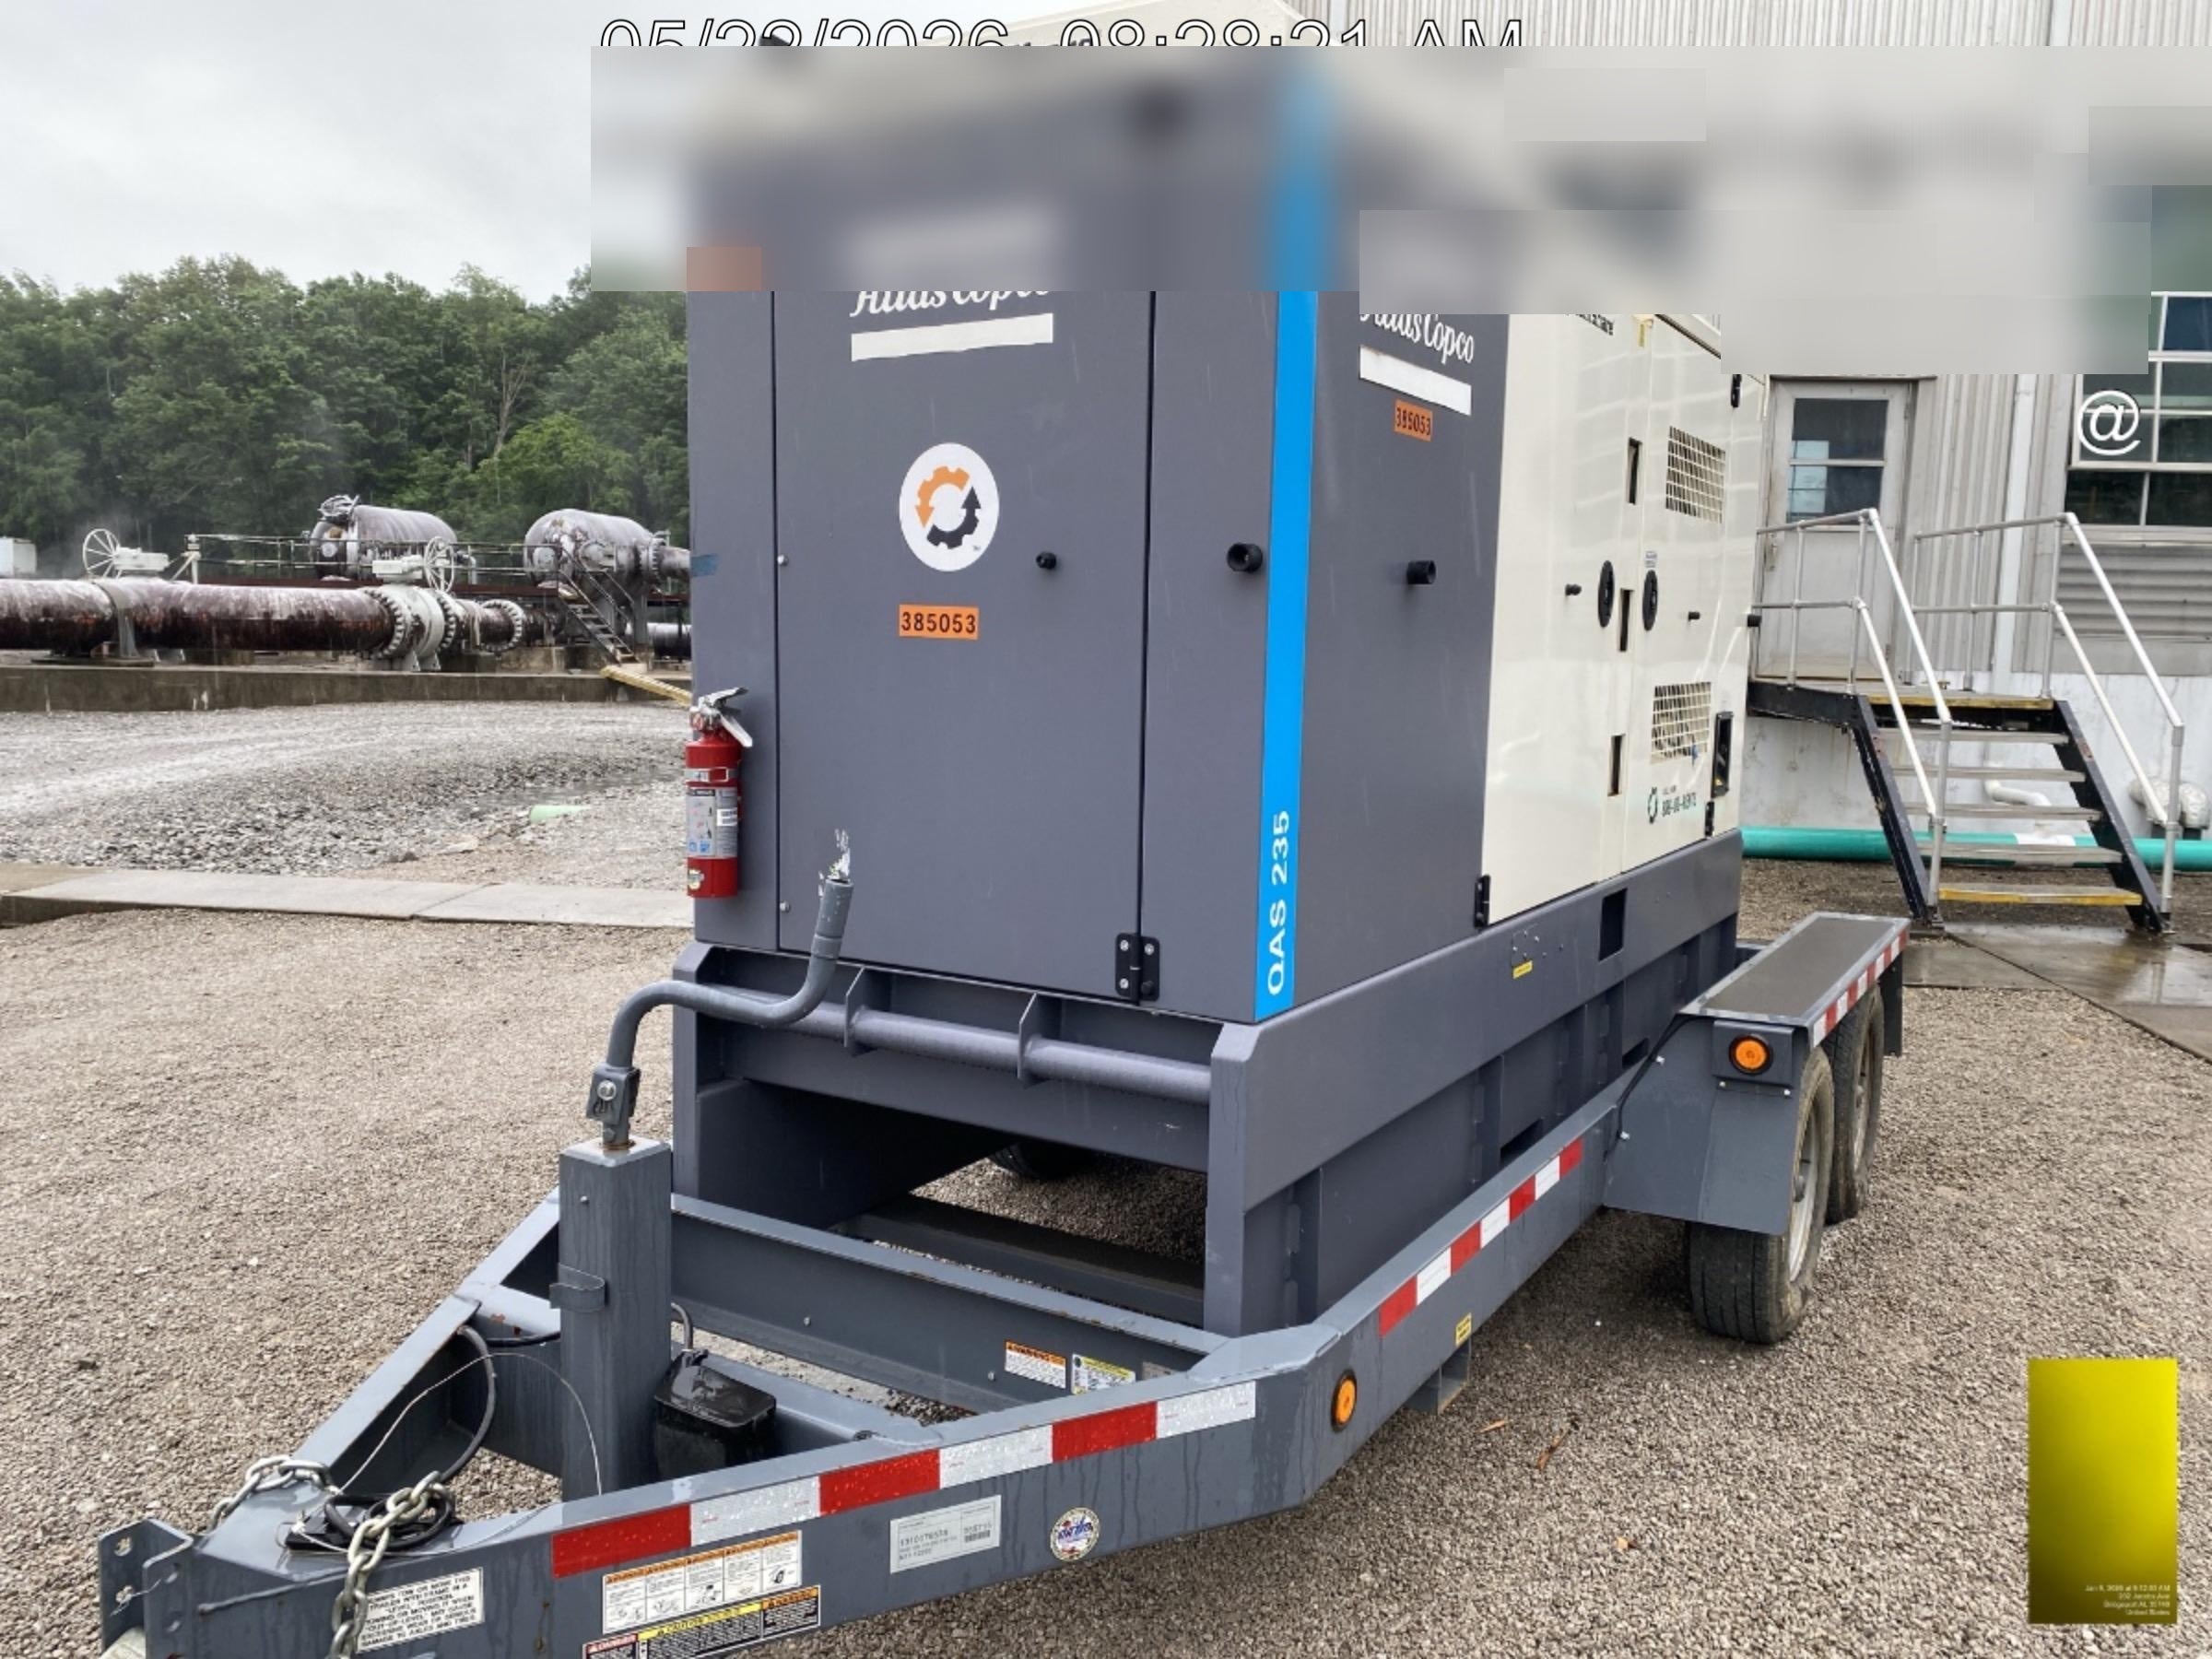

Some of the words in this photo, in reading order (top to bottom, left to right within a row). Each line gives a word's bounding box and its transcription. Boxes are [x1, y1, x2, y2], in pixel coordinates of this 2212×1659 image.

[1396, 406, 1431, 436] 385053
[900, 611, 977, 634] 385053
[1270, 810, 1290, 886] 235
[1267, 899, 1288, 996] QAS
